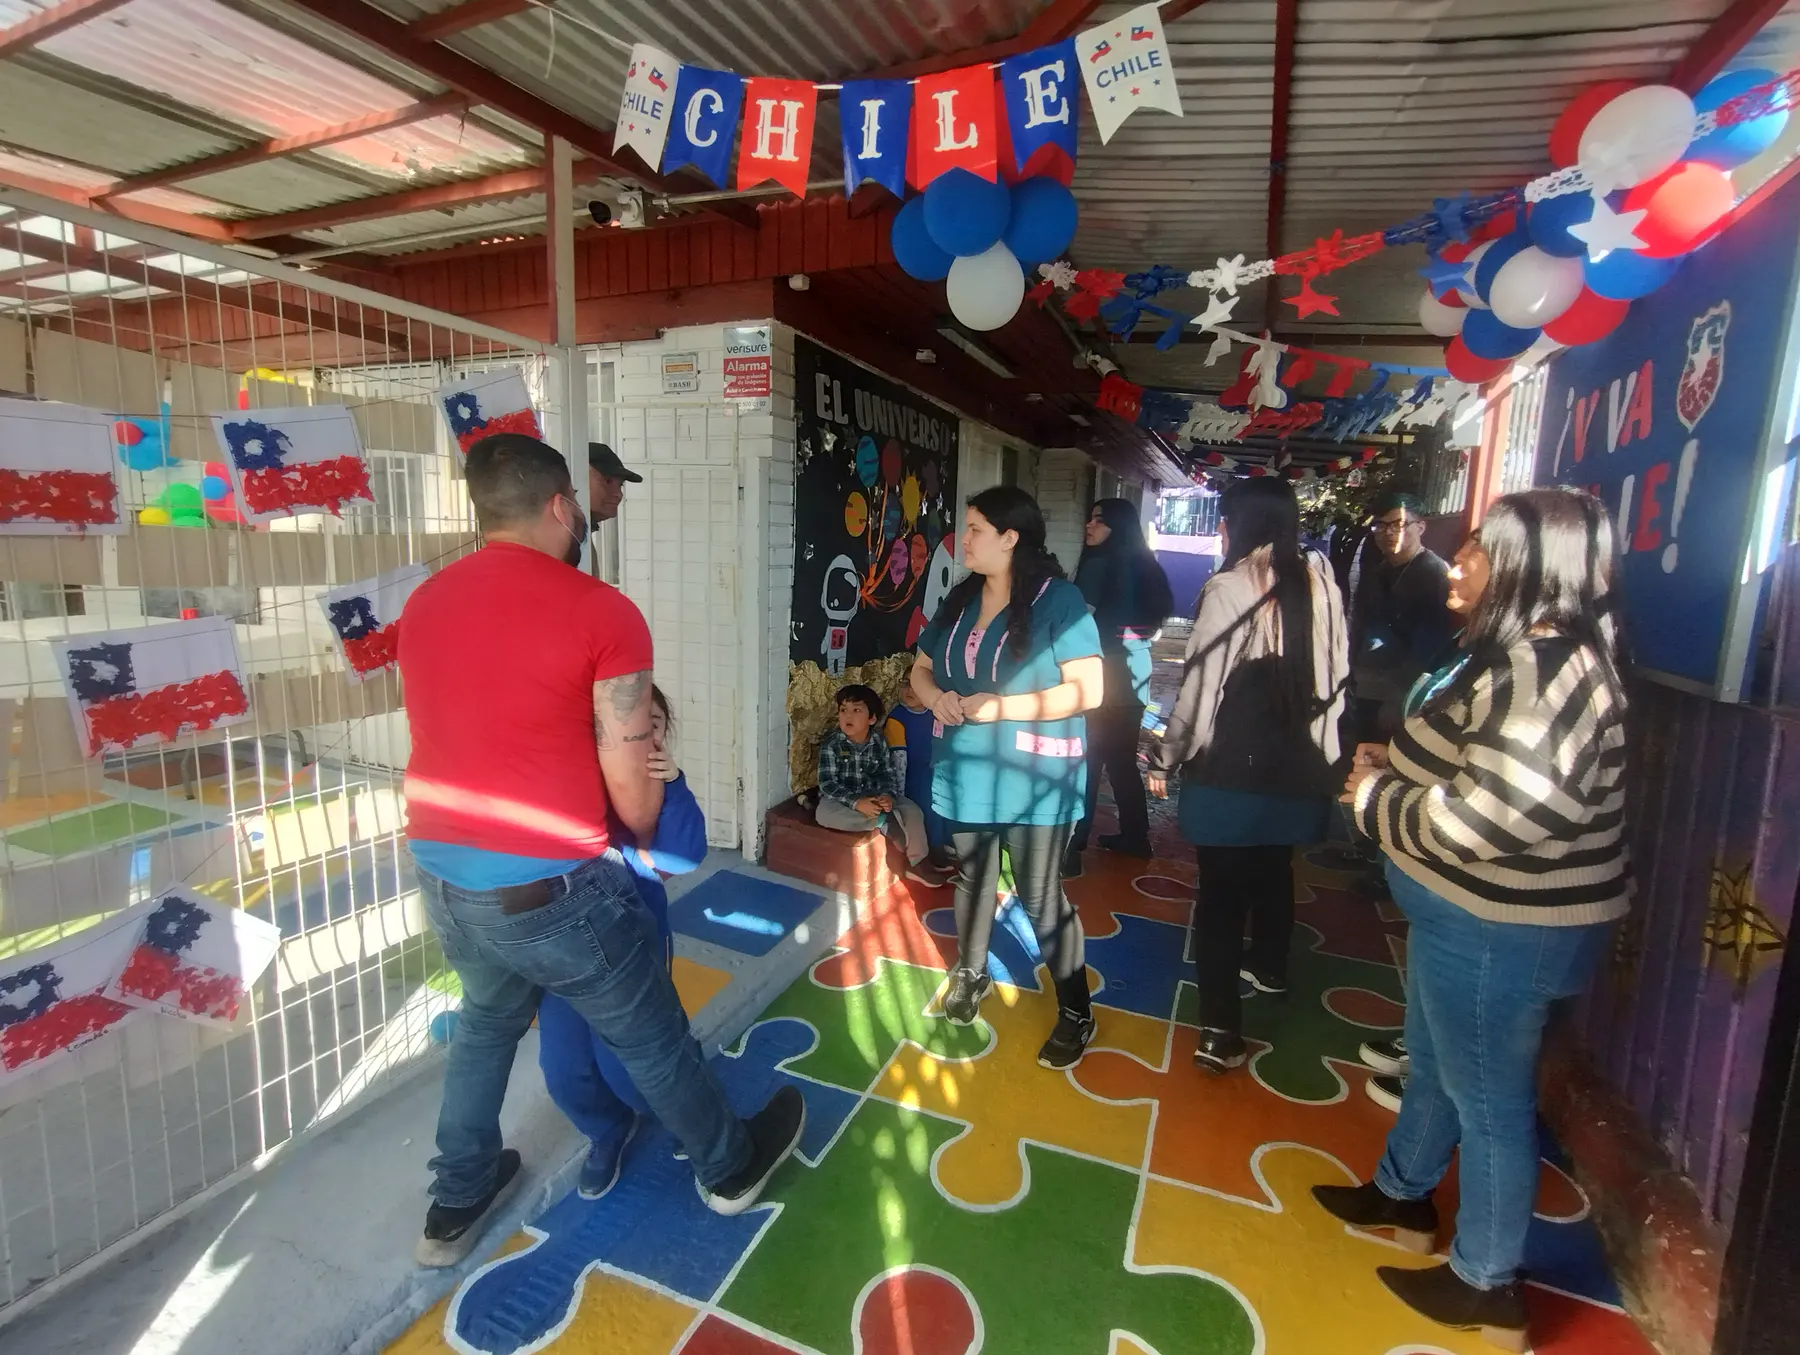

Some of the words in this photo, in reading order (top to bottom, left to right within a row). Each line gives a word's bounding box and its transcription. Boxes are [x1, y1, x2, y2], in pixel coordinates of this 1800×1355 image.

[1096, 50, 1162, 88] CHILE
[623, 91, 664, 120] CHILE
[684, 60, 1070, 162] CHILE
[726, 344, 768, 354] verisure
[726, 361, 767, 372] Alarma
[815, 372, 849, 425] EL
[854, 388, 950, 456] UNIVERSO
